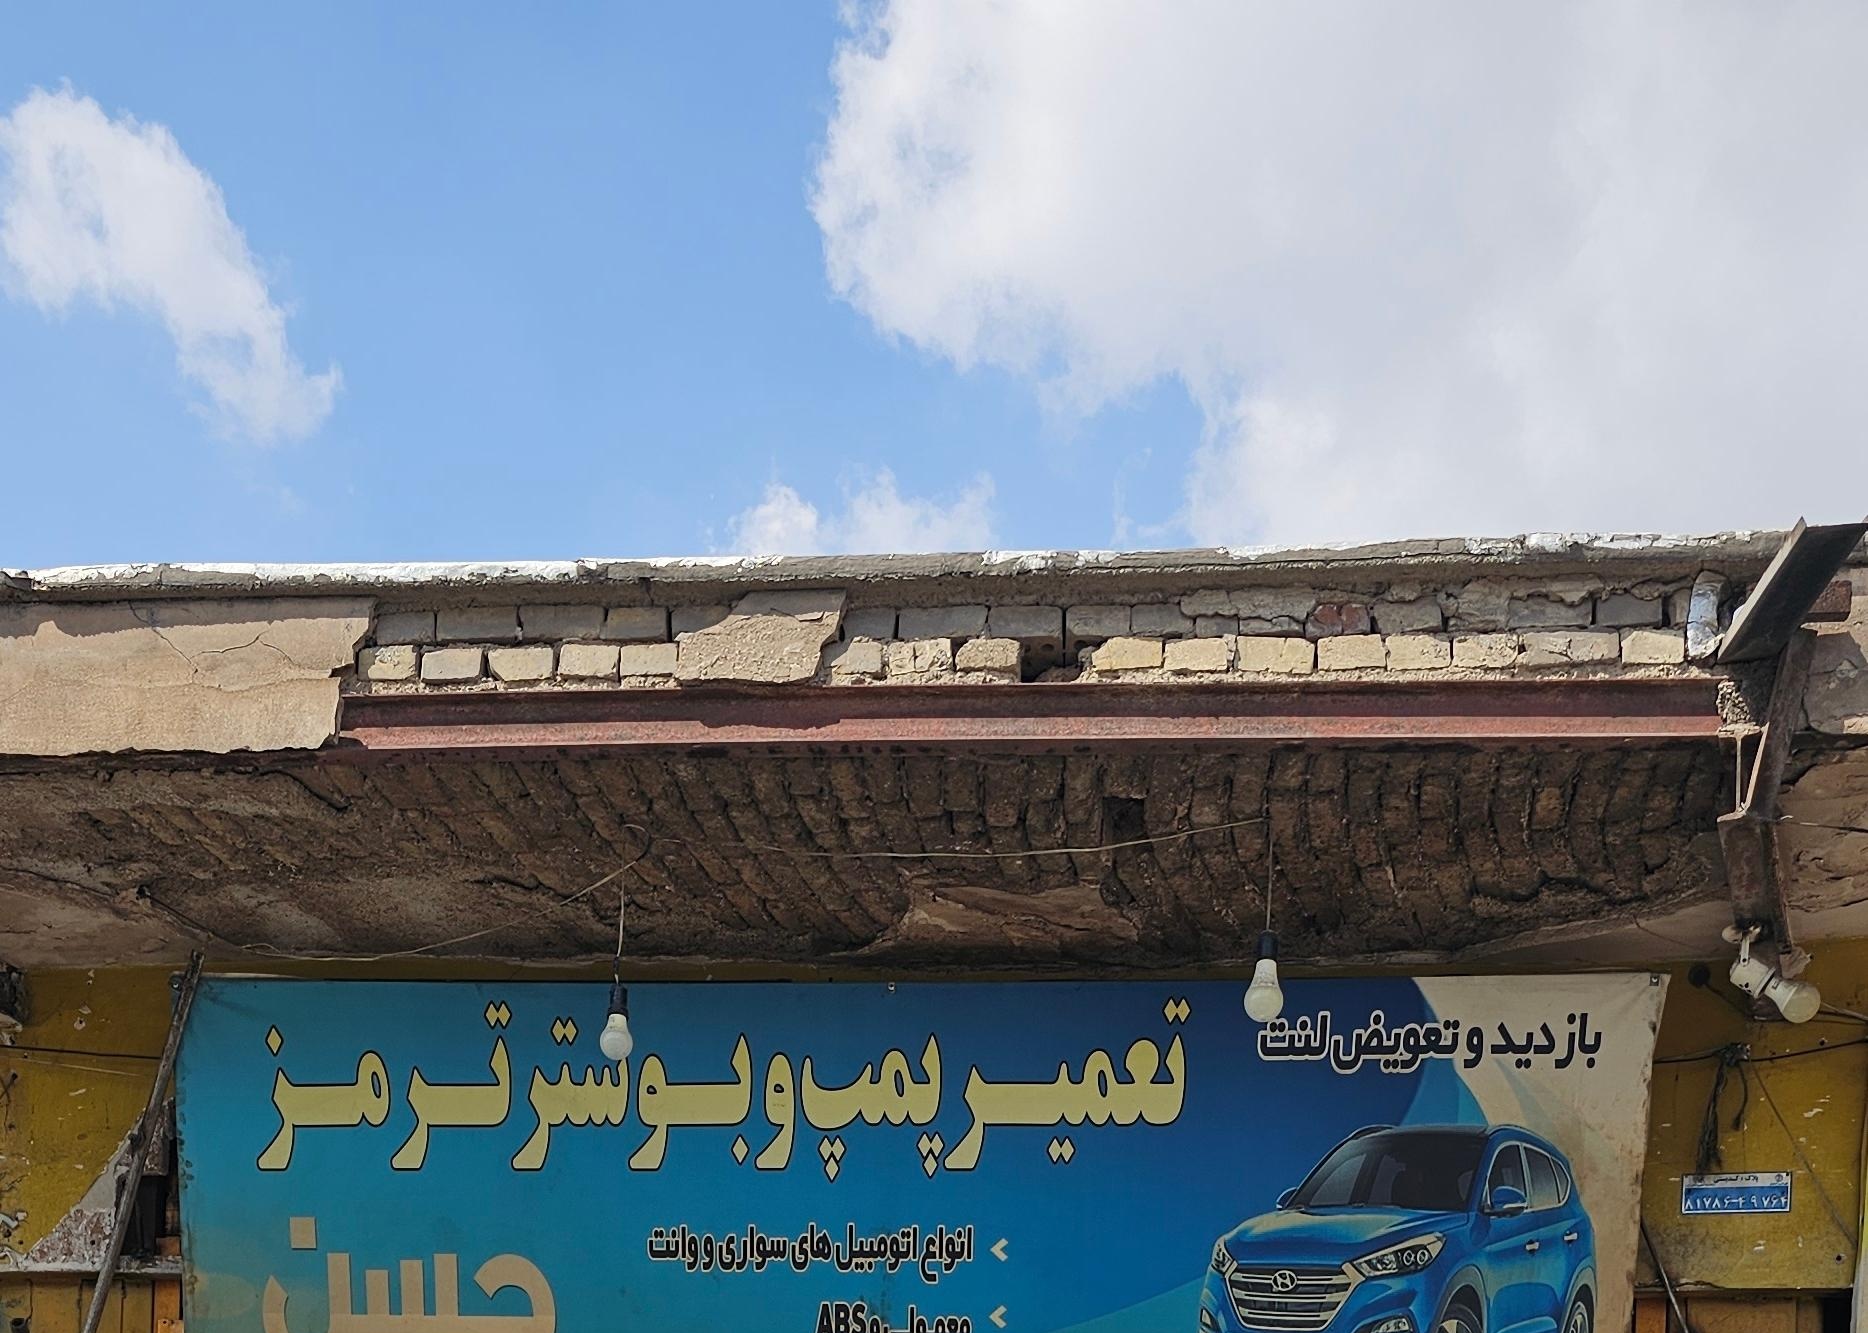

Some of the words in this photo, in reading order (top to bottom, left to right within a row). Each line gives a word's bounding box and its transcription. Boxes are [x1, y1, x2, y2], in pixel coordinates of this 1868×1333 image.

[1257, 1011, 1330, 1060] لنت
[1330, 1009, 1460, 1075] تعویض
[1463, 1025, 1484, 1069] و
[1491, 1012, 1602, 1070] بازدید
[257, 1001, 512, 1171] ترمز
[511, 1018, 753, 1171] بوستر
[756, 1051, 794, 1171] و
[801, 1032, 943, 1181] پمپ
[945, 997, 1192, 1171] تعمیر
[647, 1224, 698, 1272] وانت
[701, 1234, 715, 1272] و
[717, 1224, 788, 1272] سواری
[790, 1222, 833, 1272] های
[834, 1222, 918, 1273] اتومبیل
[920, 1224, 974, 1284] انواع
